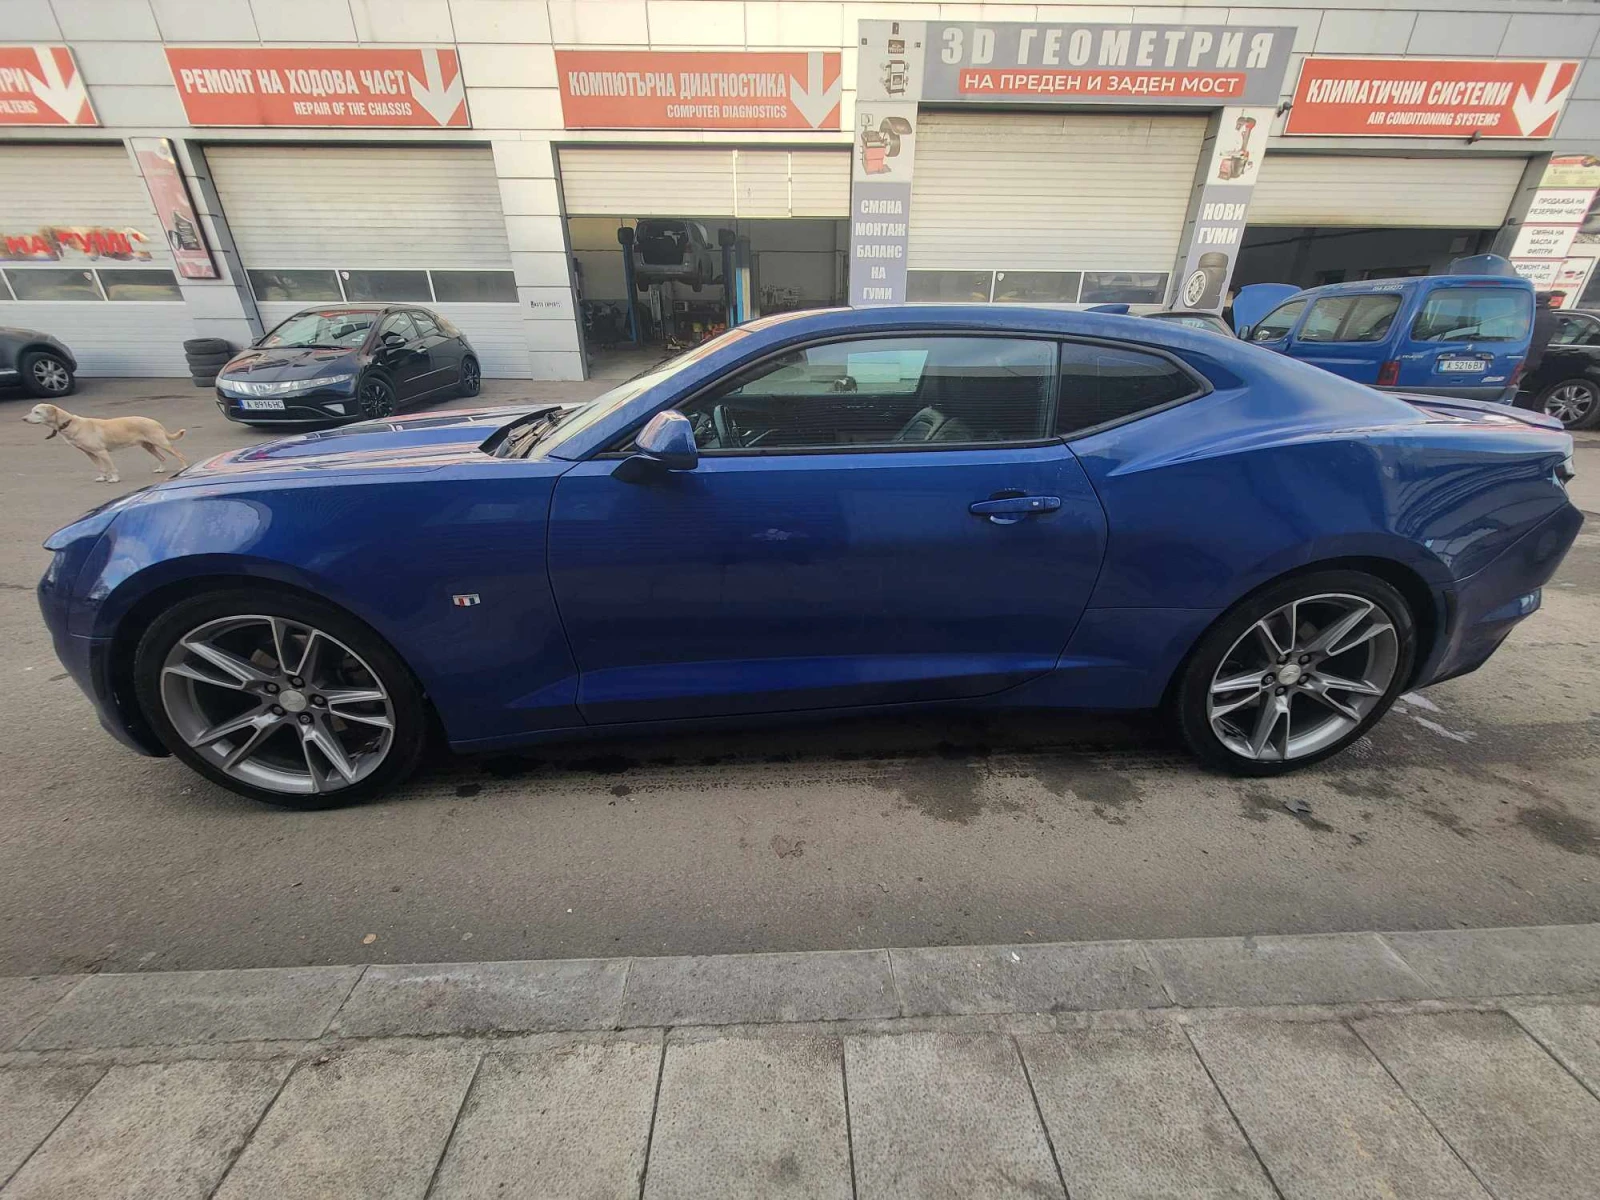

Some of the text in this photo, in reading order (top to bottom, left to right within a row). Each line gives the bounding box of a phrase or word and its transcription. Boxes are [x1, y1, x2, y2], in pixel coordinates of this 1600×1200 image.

[941, 27, 1275, 69] 3D ГЕОМЕТРИЯ
[180, 69, 406, 97] РЕМОНТ НА ХОДОВА ЧАСТ
[568, 71, 787, 100] КОМПЮТЪРНА ДИАГНОСТИКА
[965, 74, 1240, 94] НА ПРЕДЕН И ЗАДЕН МОСТ
[1306, 79, 1514, 106] КЛИМАТИЧНИ СИСТЕМИ
[293, 102, 413, 116] REPAIR OF THE CHASSIS
[667, 104, 787, 118] COMPUTER DIAGNOSTICS
[1367, 112, 1501, 126] AIR CONDITIONING SYSTEMS
[860, 199, 903, 215] СМЯНА
[1202, 203, 1246, 221] НОВИ
[855, 222, 906, 236] МОНТАЖ
[1197, 227, 1239, 245] ГУМИ
[856, 244, 903, 258] БАЛАНС
[870, 266, 886, 279] НА
[862, 287, 893, 300] ГУМИ
